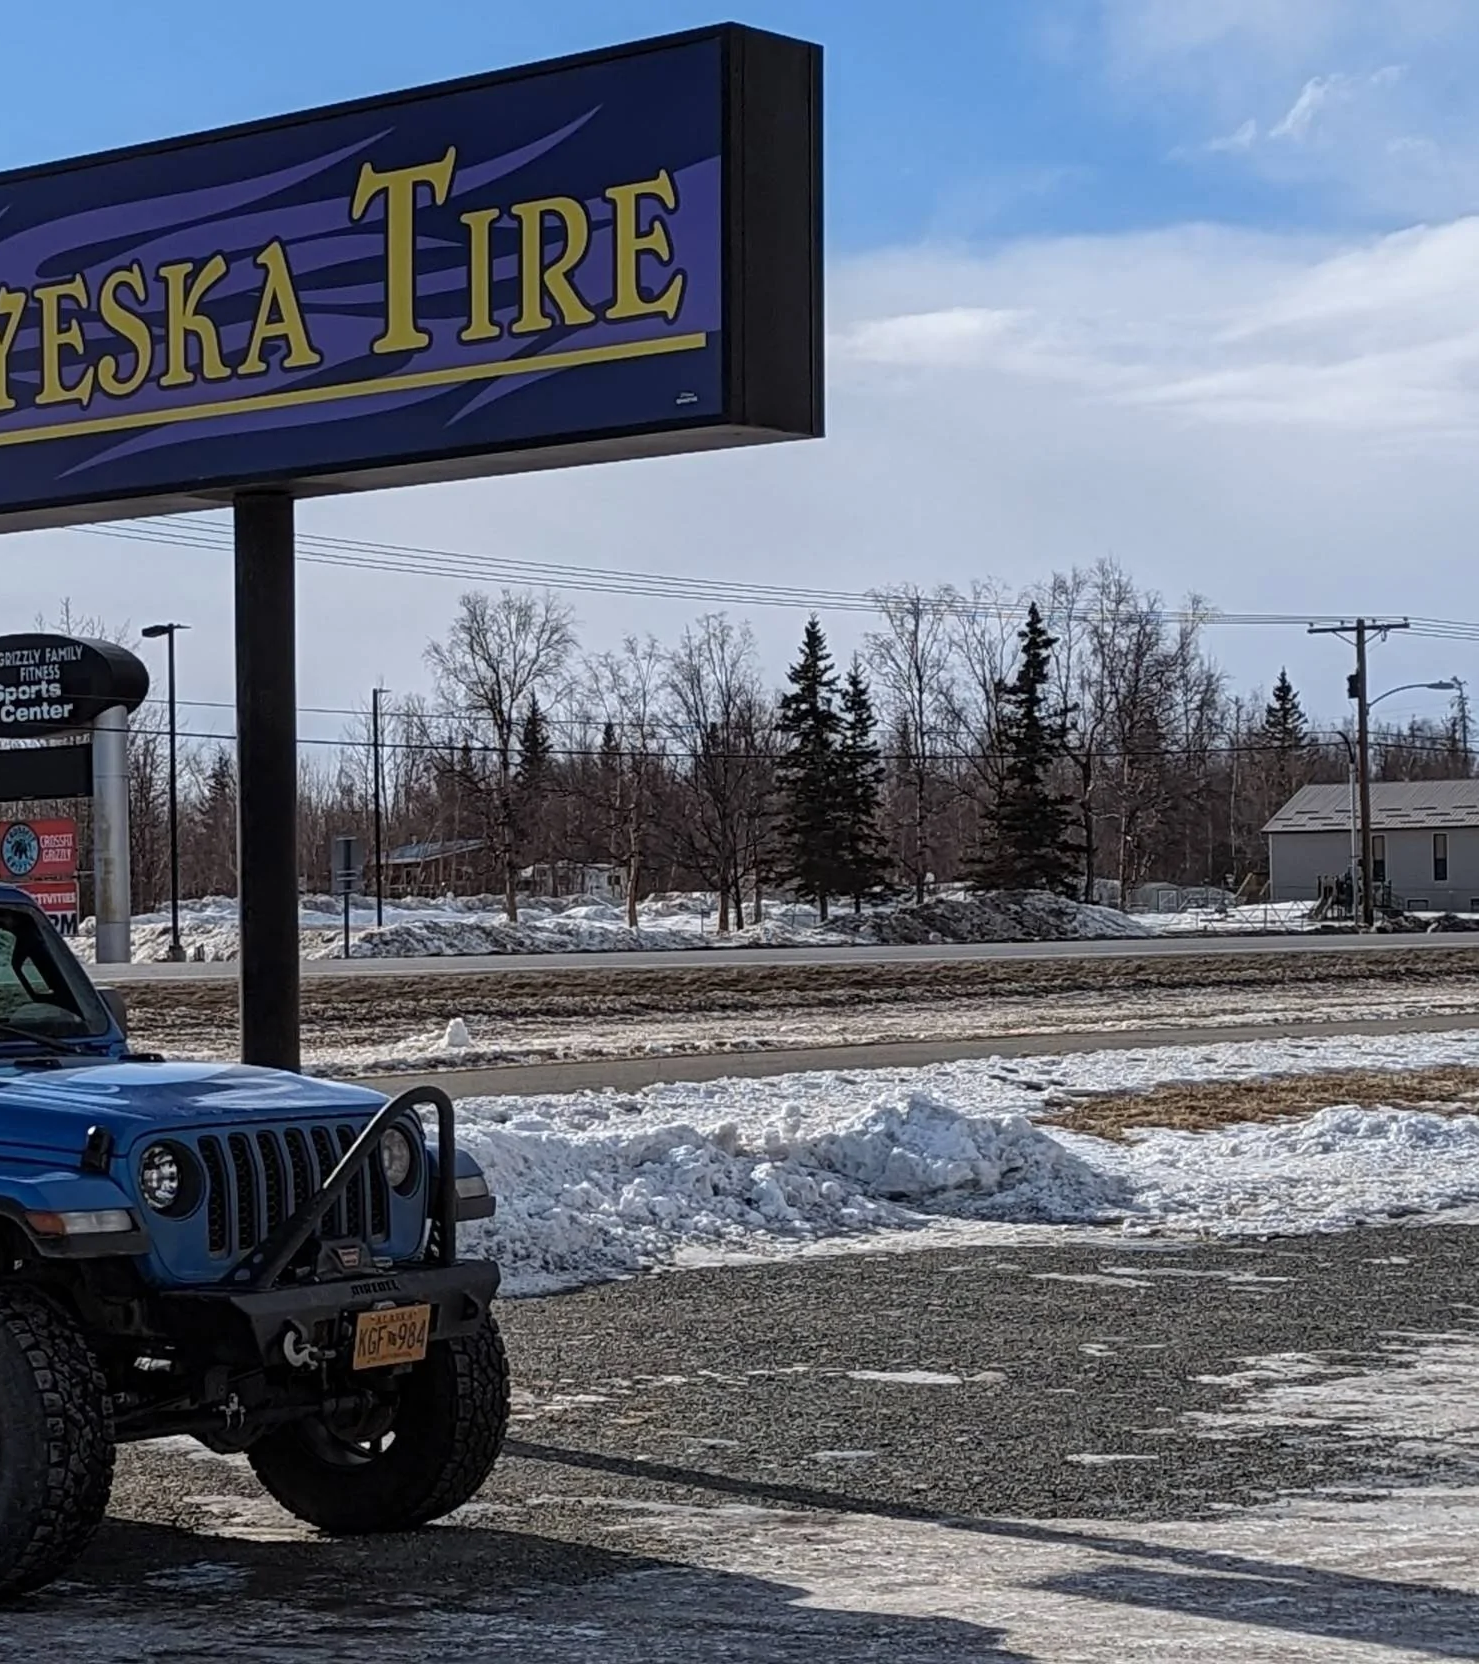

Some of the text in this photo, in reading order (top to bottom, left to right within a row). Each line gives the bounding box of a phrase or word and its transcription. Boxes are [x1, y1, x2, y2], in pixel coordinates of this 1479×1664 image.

[352, 146, 684, 355] TIRE
[45, 645, 83, 662] FAMILY
[20, 664, 60, 681] FITNESS
[1, 701, 73, 722] Center
